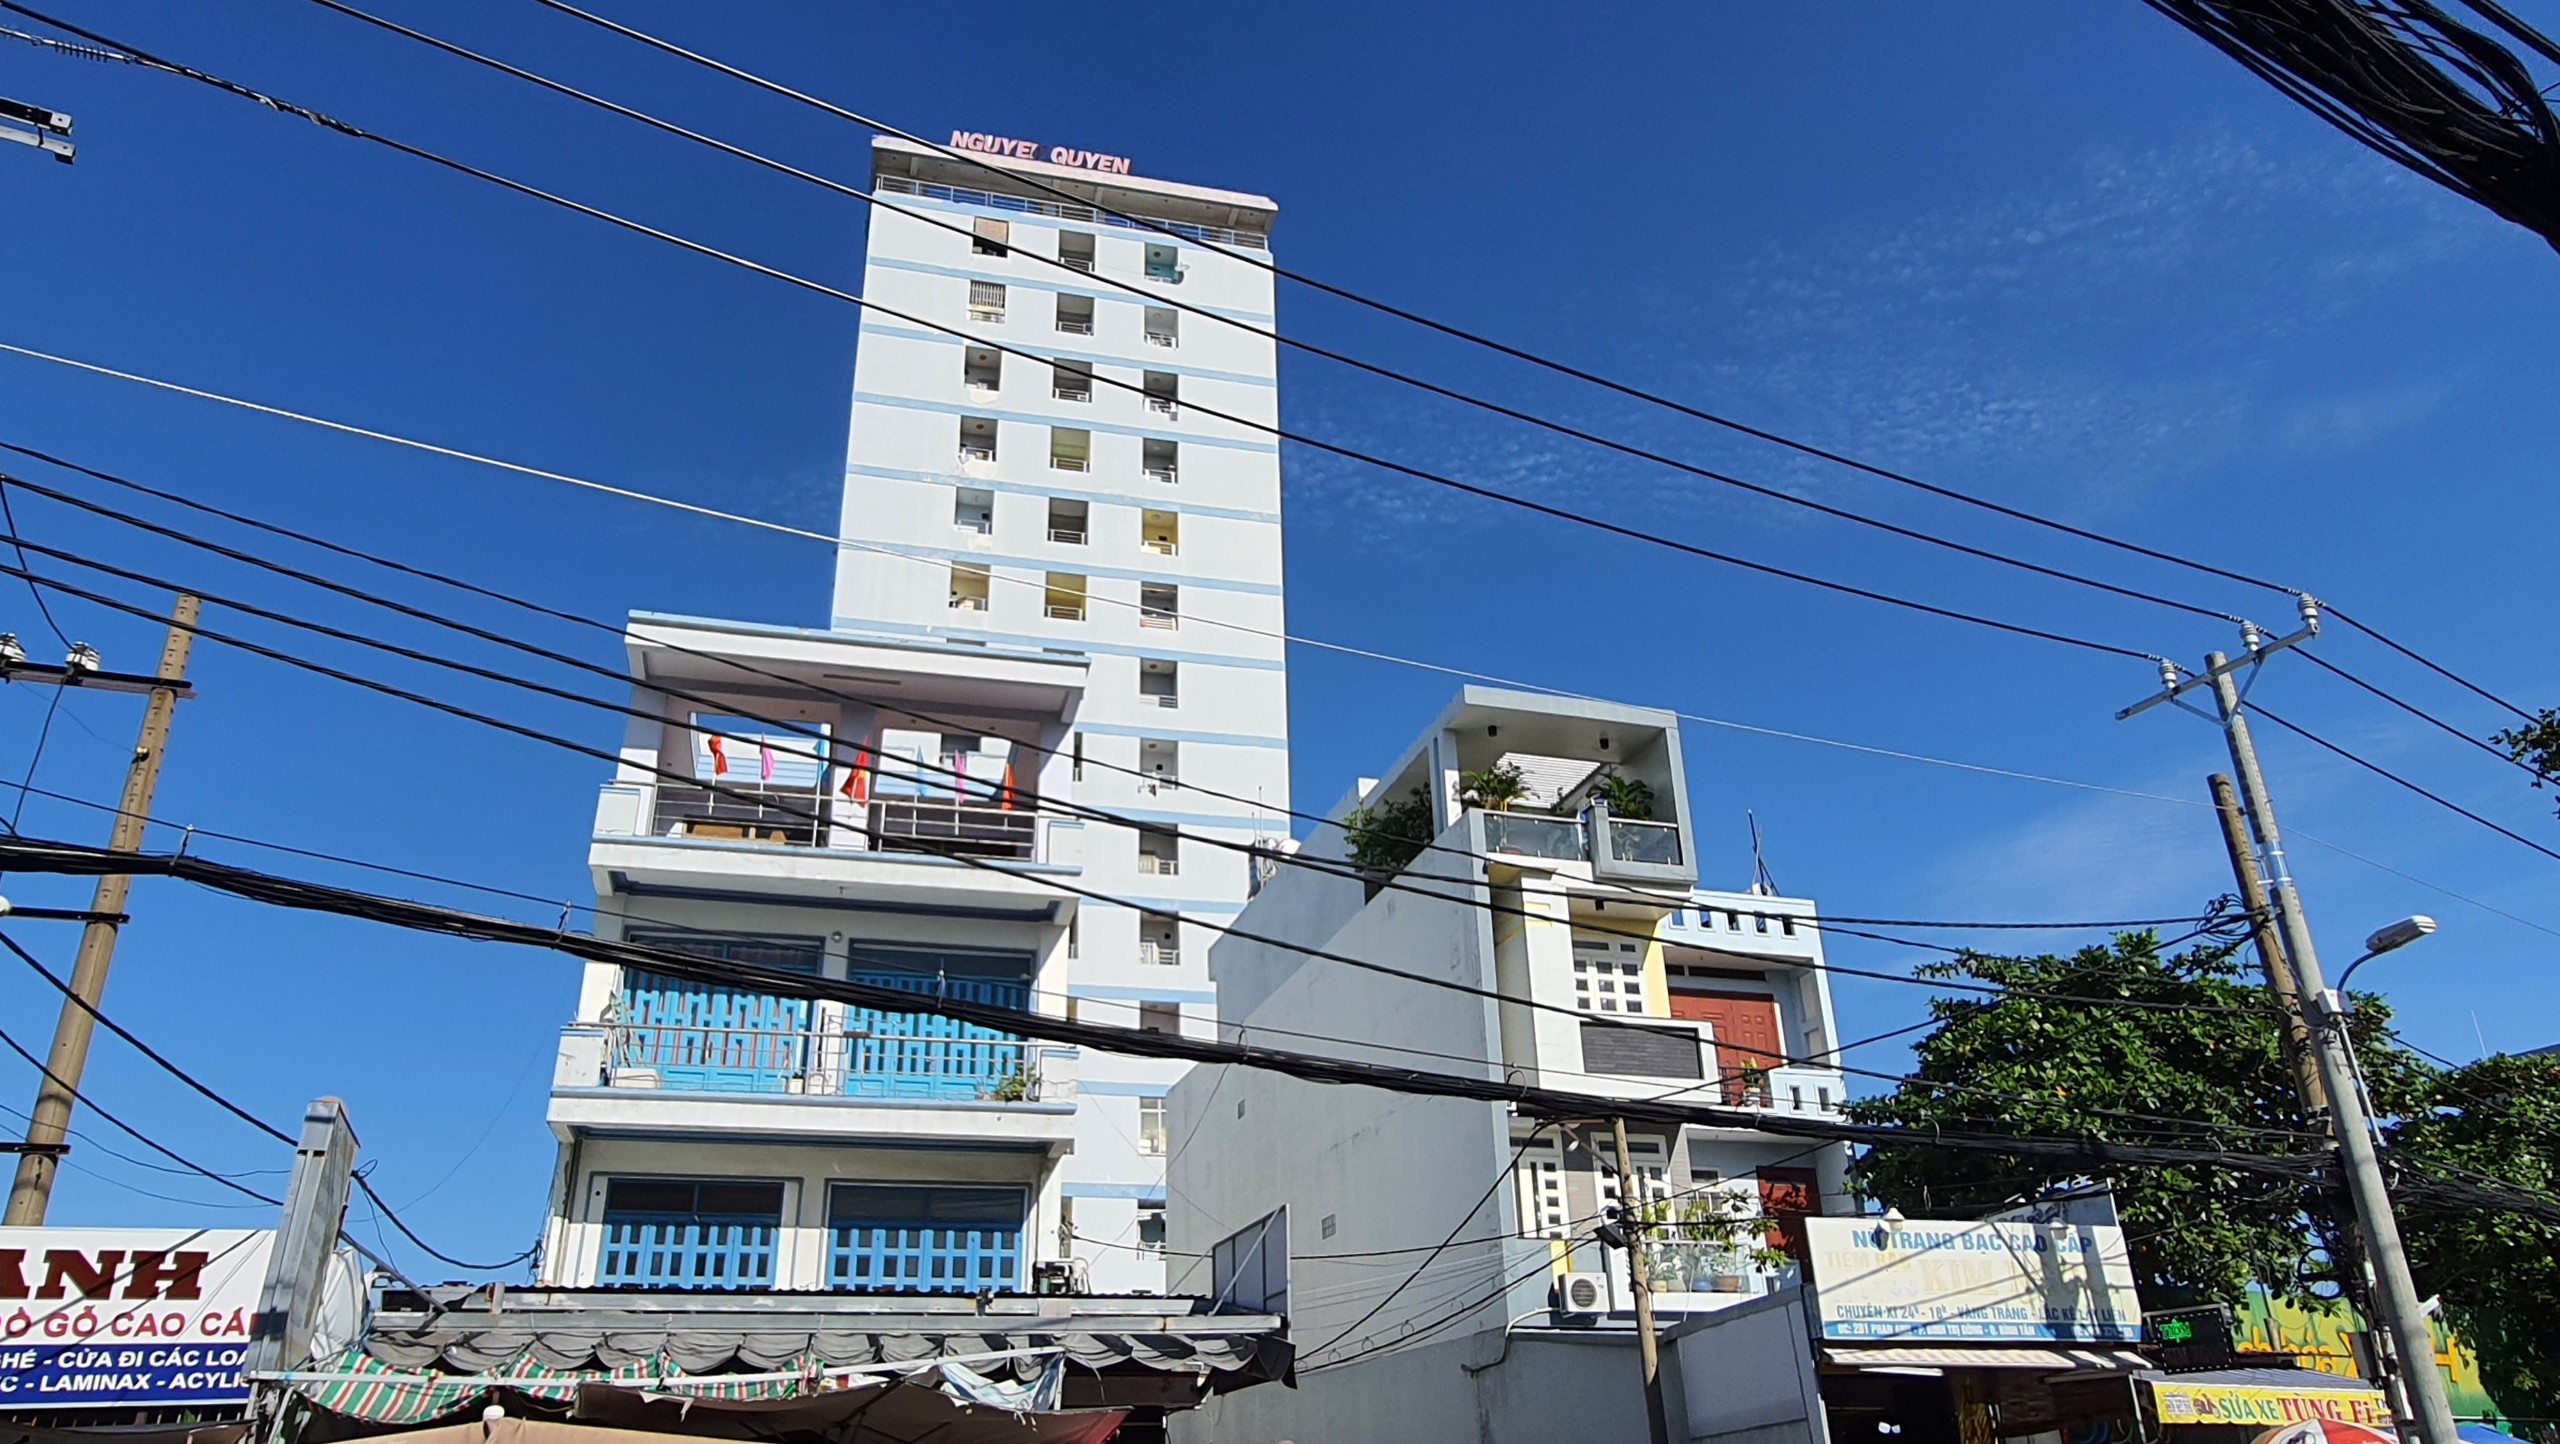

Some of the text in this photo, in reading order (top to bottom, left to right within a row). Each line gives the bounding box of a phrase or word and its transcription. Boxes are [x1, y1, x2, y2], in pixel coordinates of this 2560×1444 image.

[1050, 146, 1132, 175] QUYEN
[1890, 1231, 1954, 1250] TRANG
[2009, 1233, 2048, 1253] CAO
[111, 1311, 186, 1337] CAO
[200, 1306, 256, 1337] CẤ
[1837, 1302, 1883, 1319] CHUYÊN
[58, 1348, 113, 1368] CỬA
[118, 1351, 144, 1368] ĐI
[149, 1346, 200, 1367] CÁC
[40, 1373, 152, 1392] LAMINAX
[2218, 1390, 2257, 1420] SỬA
[2255, 1399, 2280, 1420] XE
[2276, 1392, 2343, 1421] TÙNG
